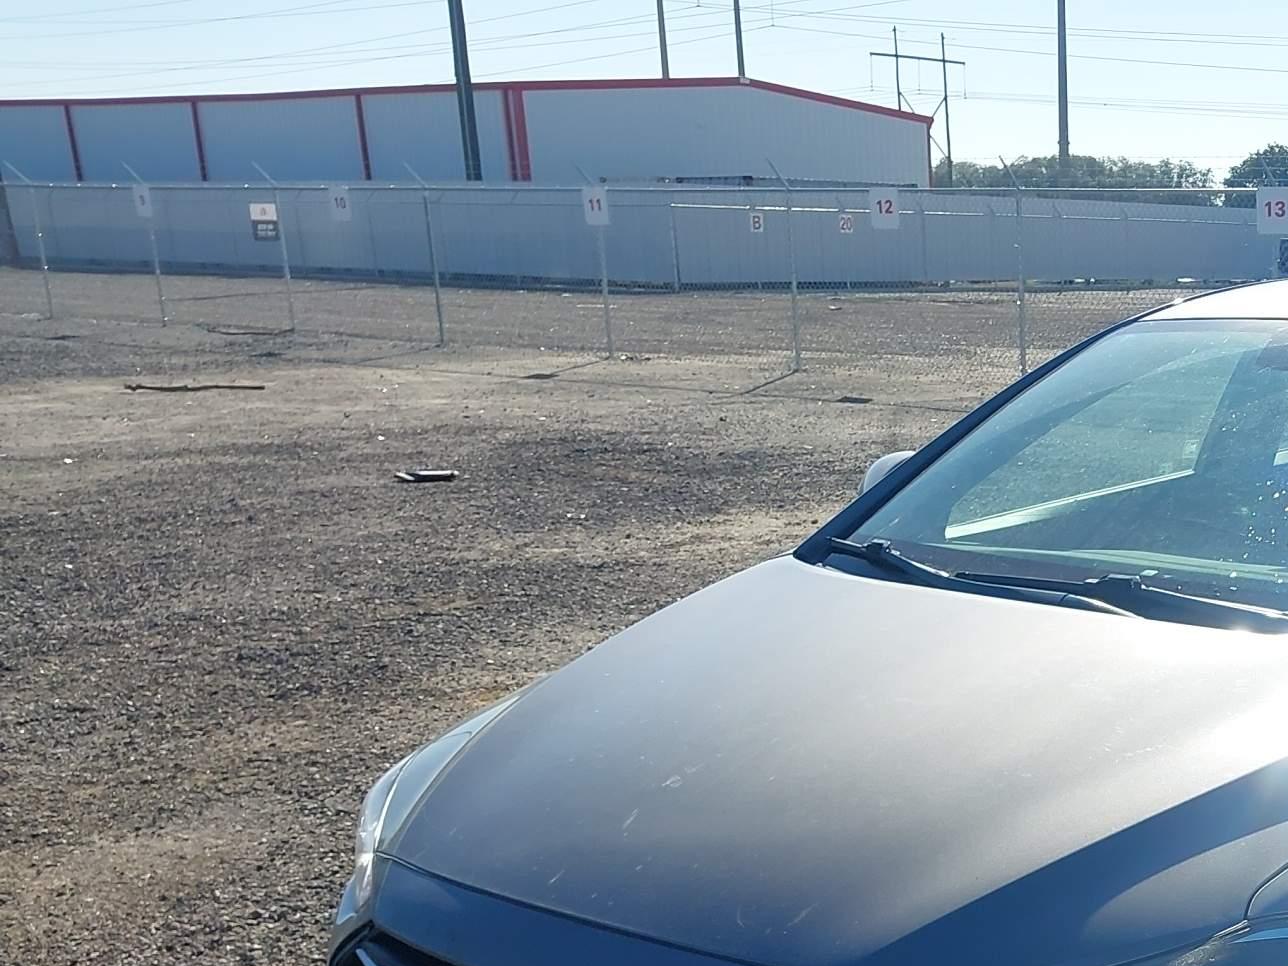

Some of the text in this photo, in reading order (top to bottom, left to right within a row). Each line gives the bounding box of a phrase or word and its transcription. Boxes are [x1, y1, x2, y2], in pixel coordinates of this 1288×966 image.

[588, 198, 602, 211] 11
[876, 199, 893, 214] 12
[1264, 200, 1286, 218] 13
